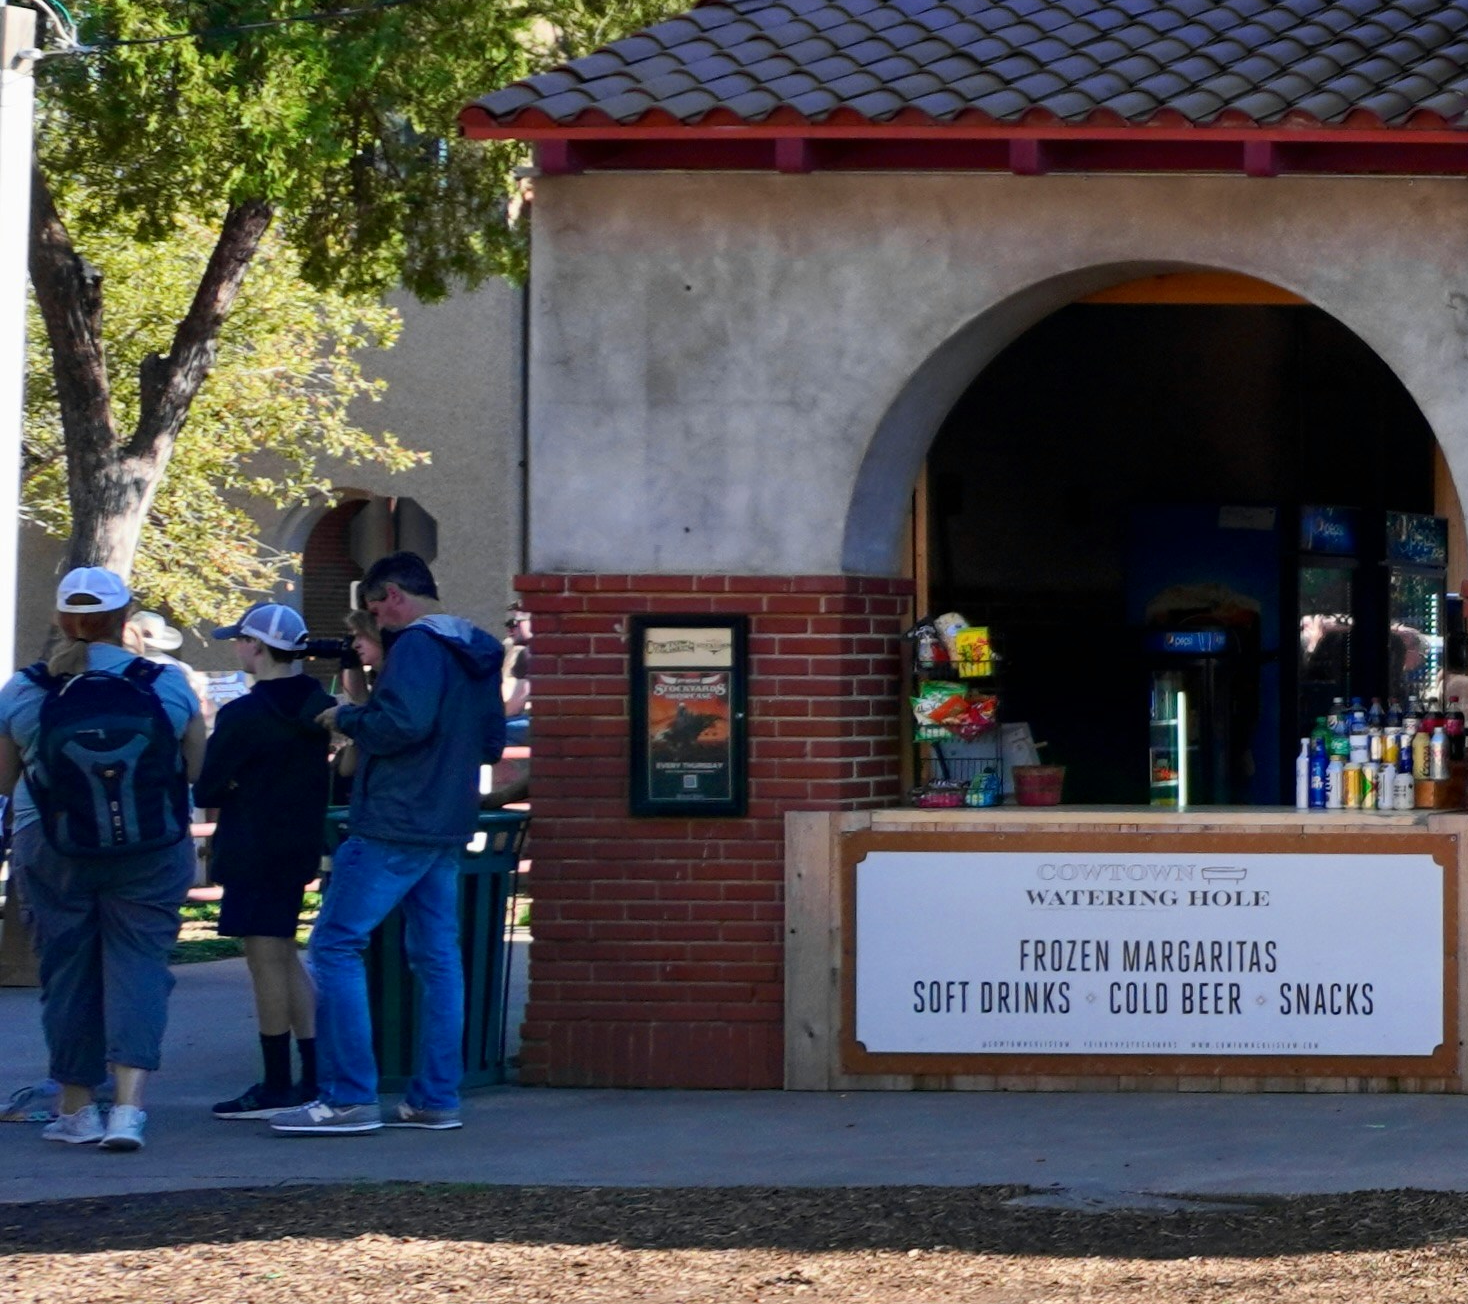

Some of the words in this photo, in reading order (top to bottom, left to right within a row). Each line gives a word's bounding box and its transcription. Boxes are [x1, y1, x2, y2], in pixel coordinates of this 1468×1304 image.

[1037, 863, 1196, 881] COWTOWN
[1025, 889, 1178, 907] WATERING
[1187, 890, 1270, 907] HOLE
[1019, 938, 1110, 973] FROZEN
[1123, 939, 1279, 974] MARGARITAS
[912, 980, 970, 1014] SOFT
[981, 981, 1072, 1015] DRINKS
[1109, 982, 1167, 1015] COLD
[1182, 982, 1244, 1016] BEER
[1280, 982, 1375, 1016] SNACKS
